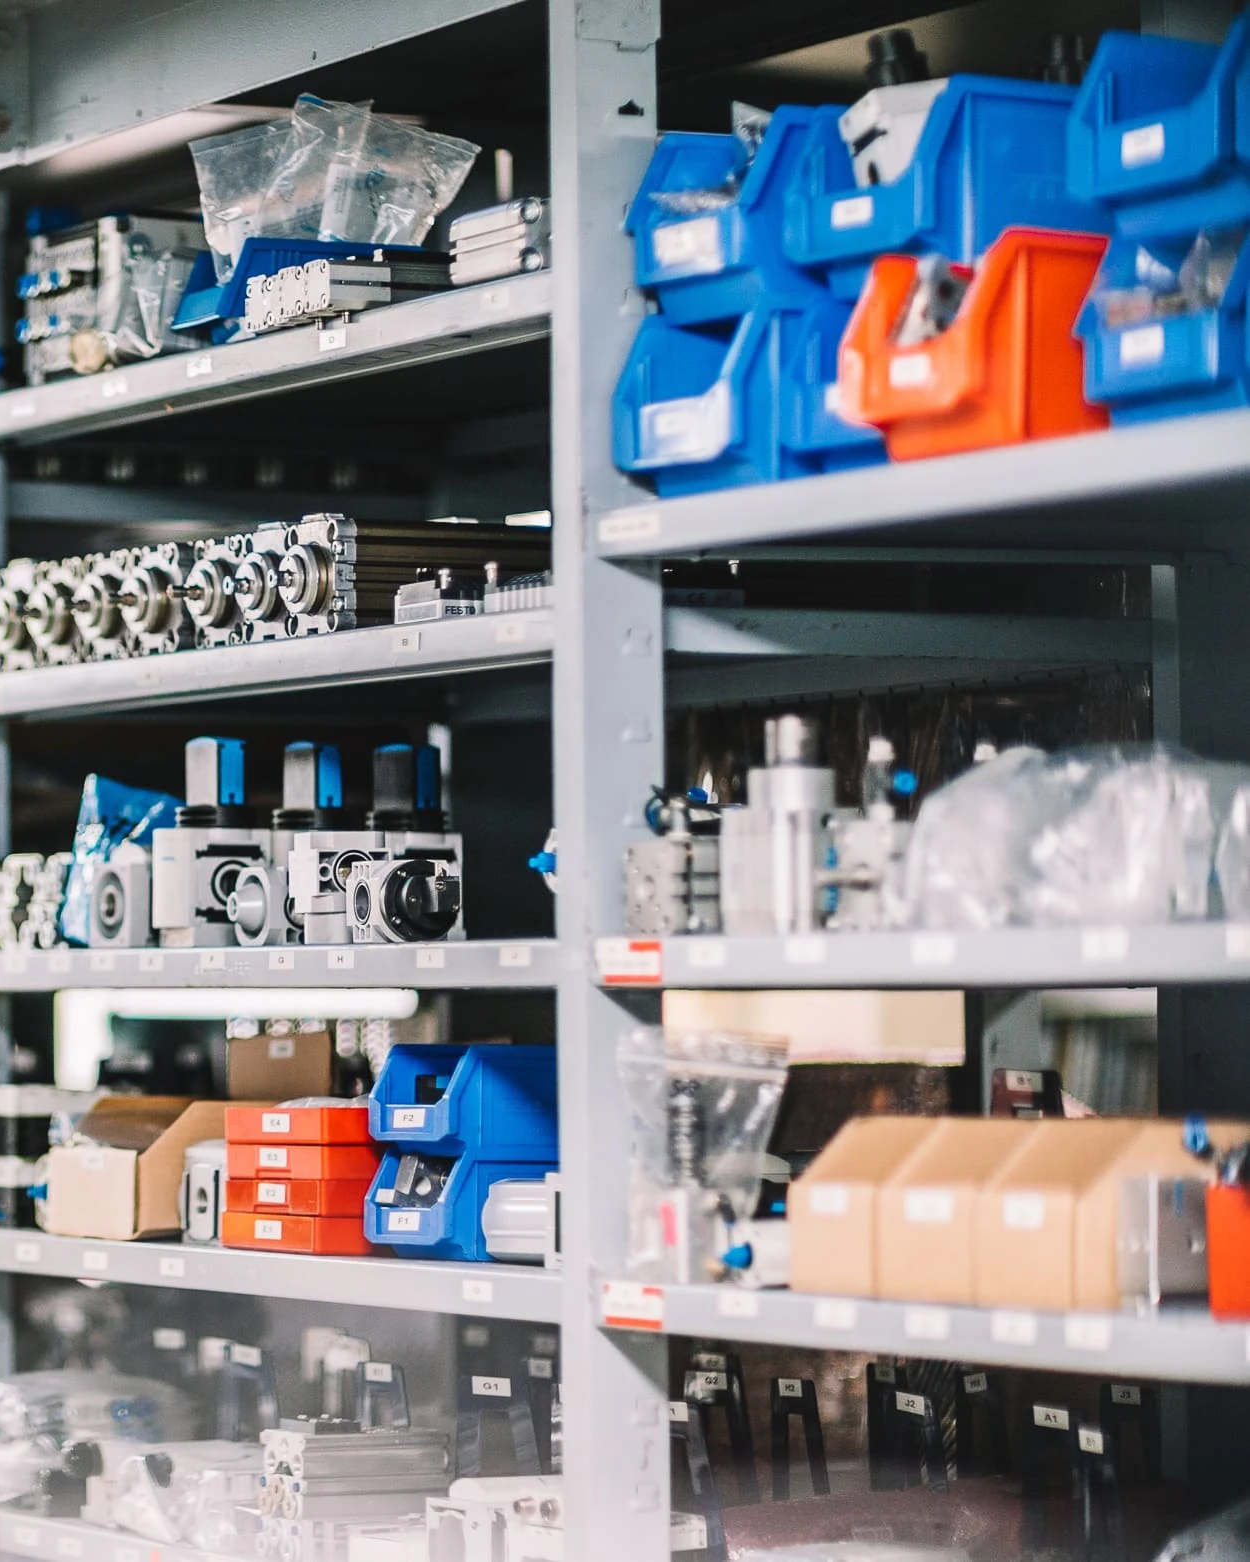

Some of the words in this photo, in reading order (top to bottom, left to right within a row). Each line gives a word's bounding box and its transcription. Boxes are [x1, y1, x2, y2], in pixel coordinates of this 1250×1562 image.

[445, 605, 476, 615] FESTO
[401, 638, 409, 647] B
[278, 956, 285, 964] G
[403, 1114, 414, 1122] F2
[397, 1217, 409, 1225] F1
[904, 1399, 916, 1409] J2
[1044, 1413, 1058, 1424] A1
